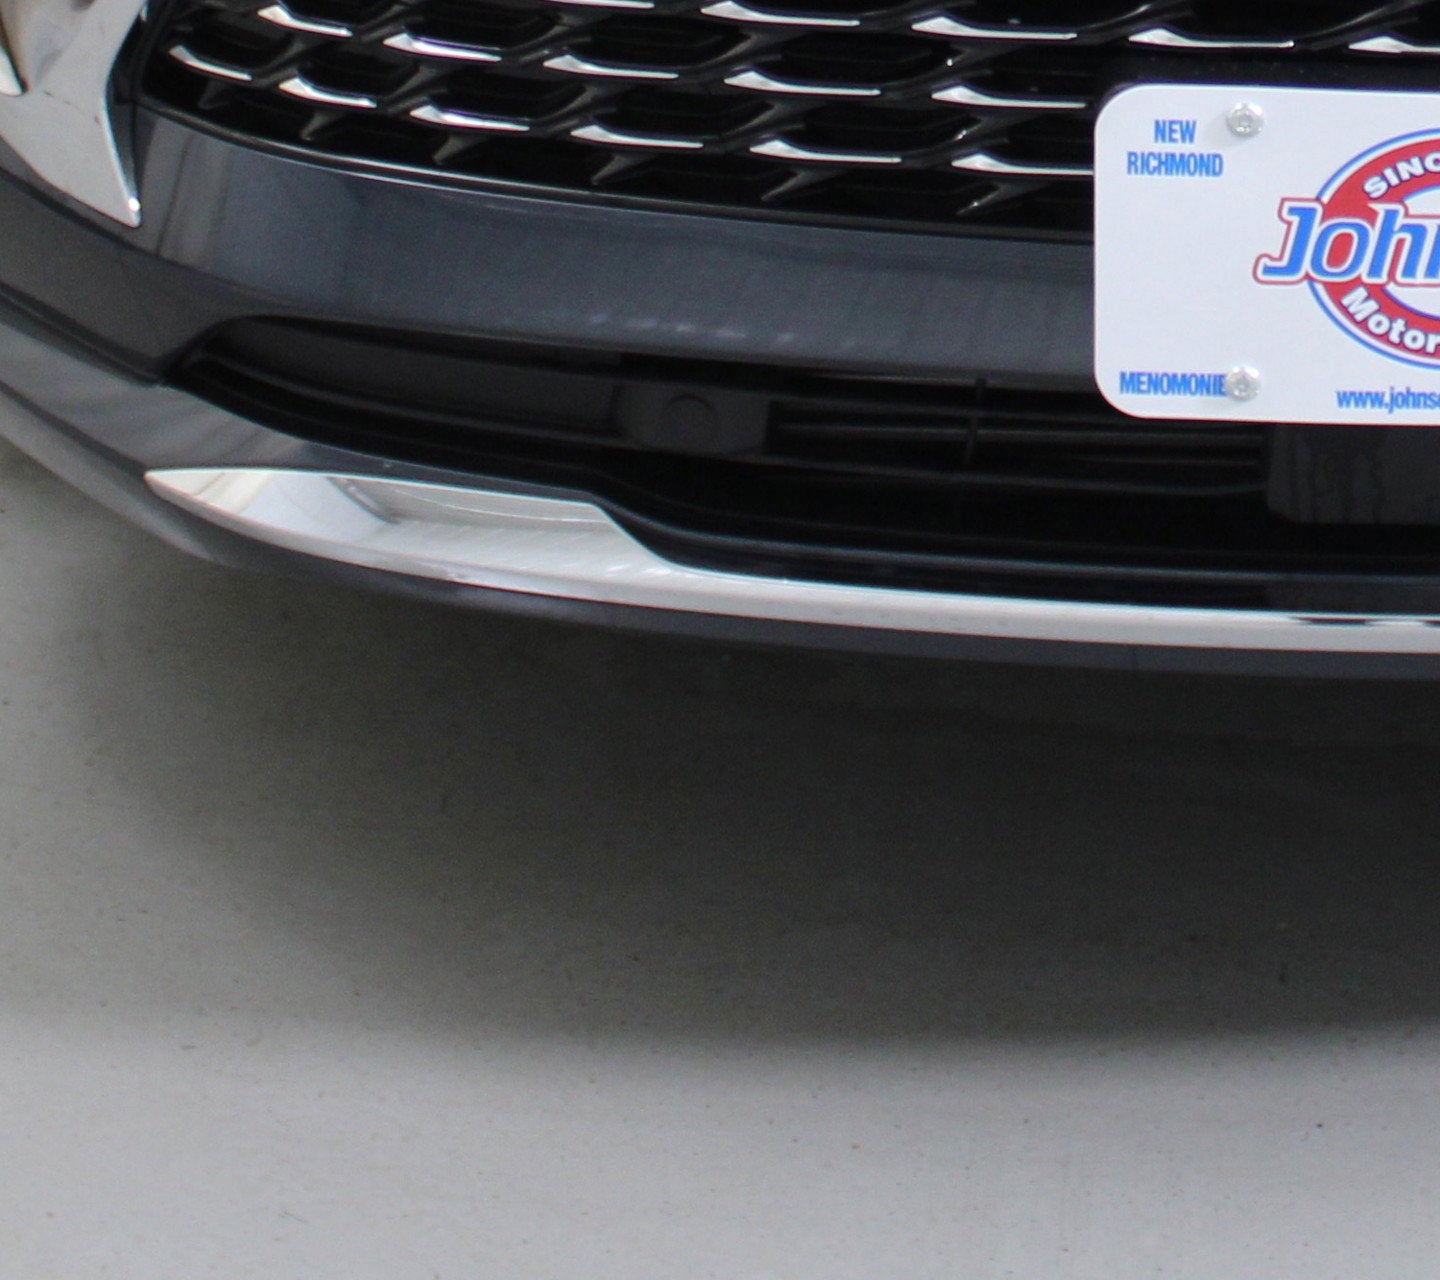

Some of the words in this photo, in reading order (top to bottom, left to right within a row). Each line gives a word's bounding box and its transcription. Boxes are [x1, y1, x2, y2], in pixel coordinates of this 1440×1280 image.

[1154, 119, 1197, 143] NEW
[1127, 151, 1224, 177] RICHMOND
[1119, 371, 1228, 397] MENOMONIE
